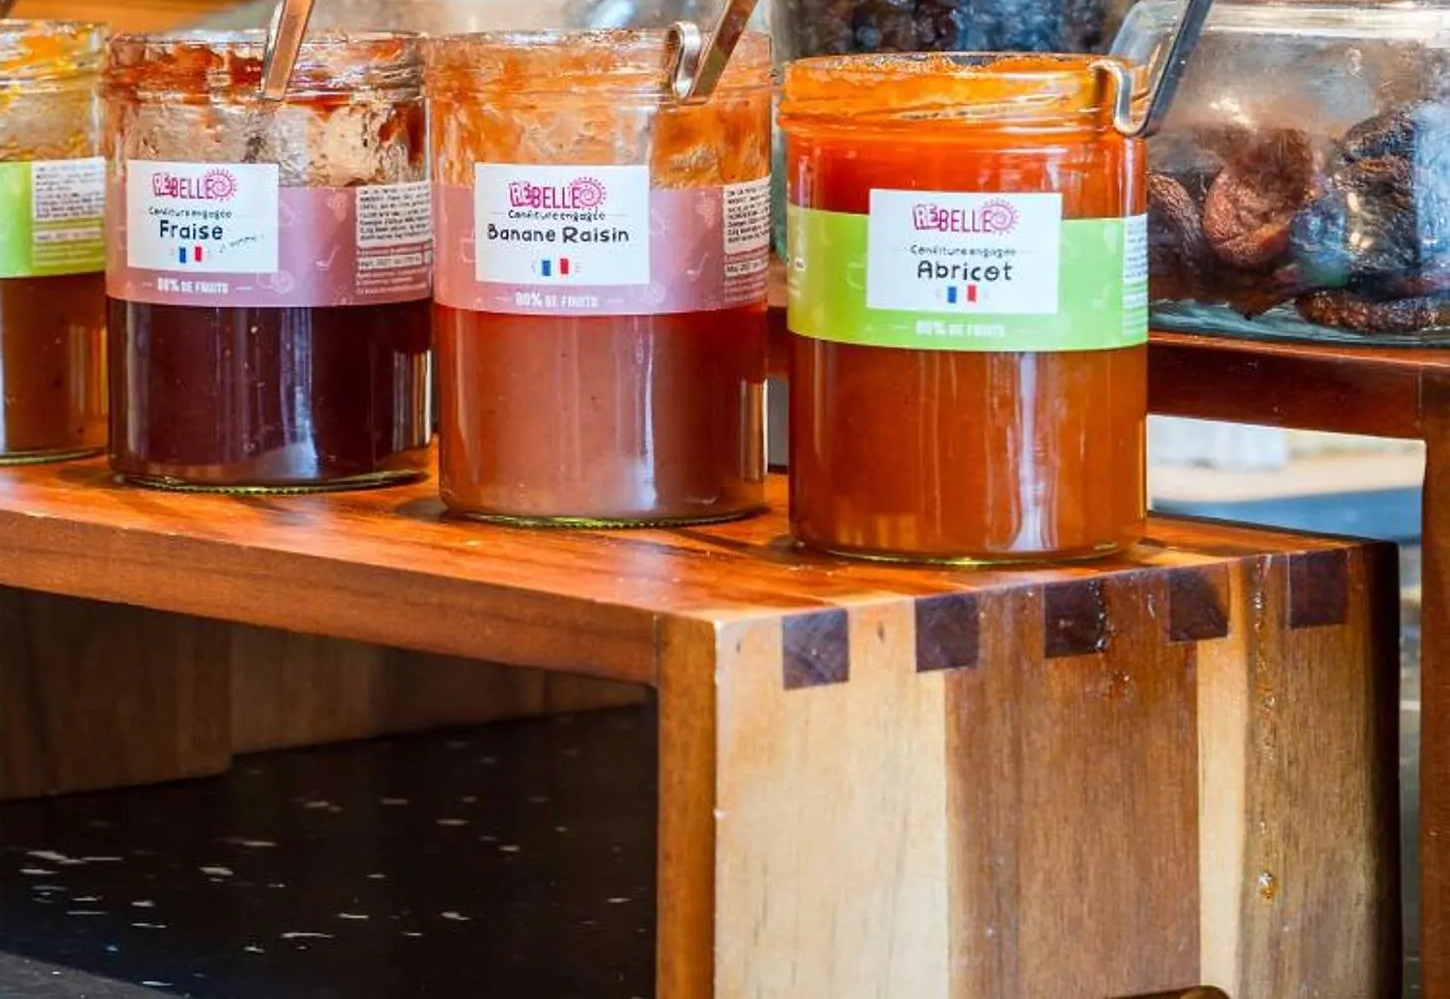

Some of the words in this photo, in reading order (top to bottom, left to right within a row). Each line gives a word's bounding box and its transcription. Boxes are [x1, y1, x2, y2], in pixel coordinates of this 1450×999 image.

[159, 219, 224, 241] Fraise
[486, 223, 557, 243] Banane
[561, 226, 630, 244] Raisin
[917, 260, 1014, 282] Abricot
